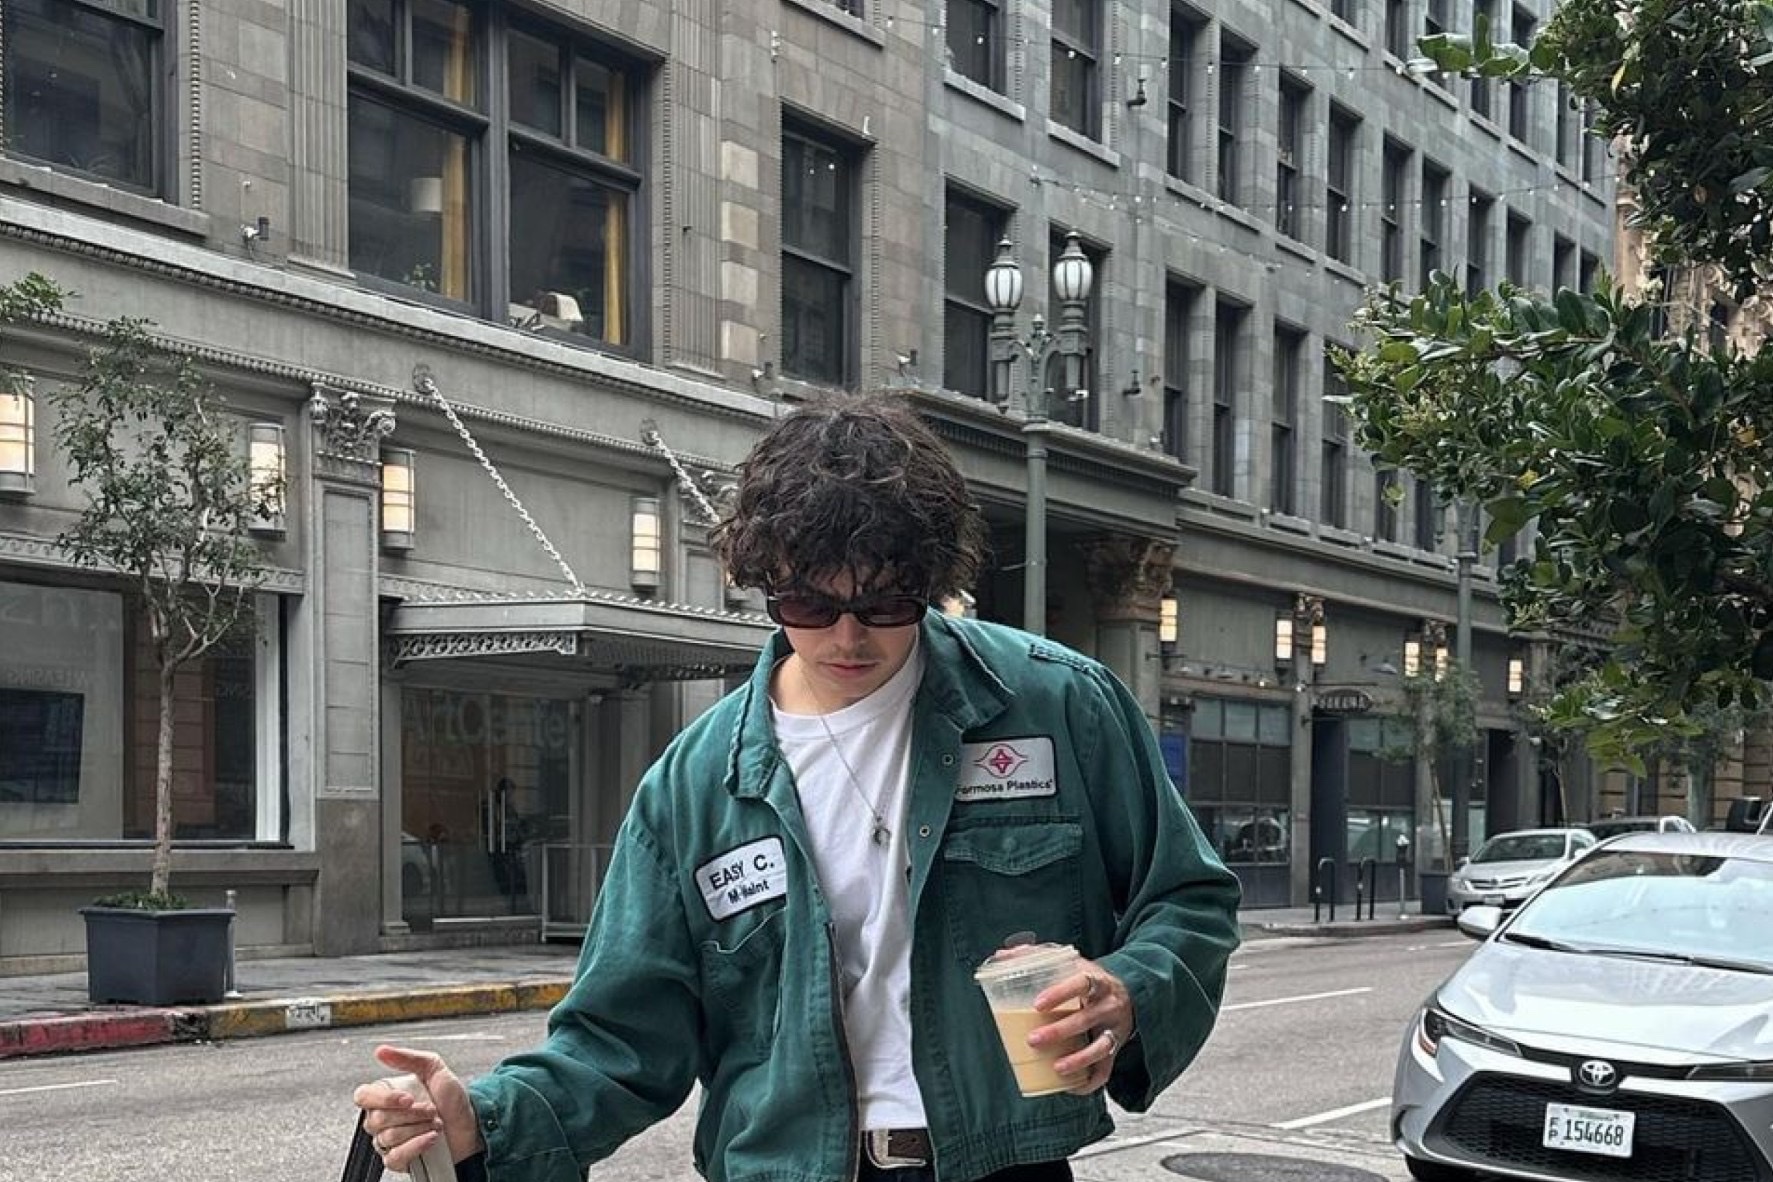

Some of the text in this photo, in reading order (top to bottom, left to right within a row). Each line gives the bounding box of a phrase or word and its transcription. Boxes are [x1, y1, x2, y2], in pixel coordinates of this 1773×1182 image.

[709, 855, 775, 890] EASY C.
[1563, 1119, 1624, 1146] 154668
